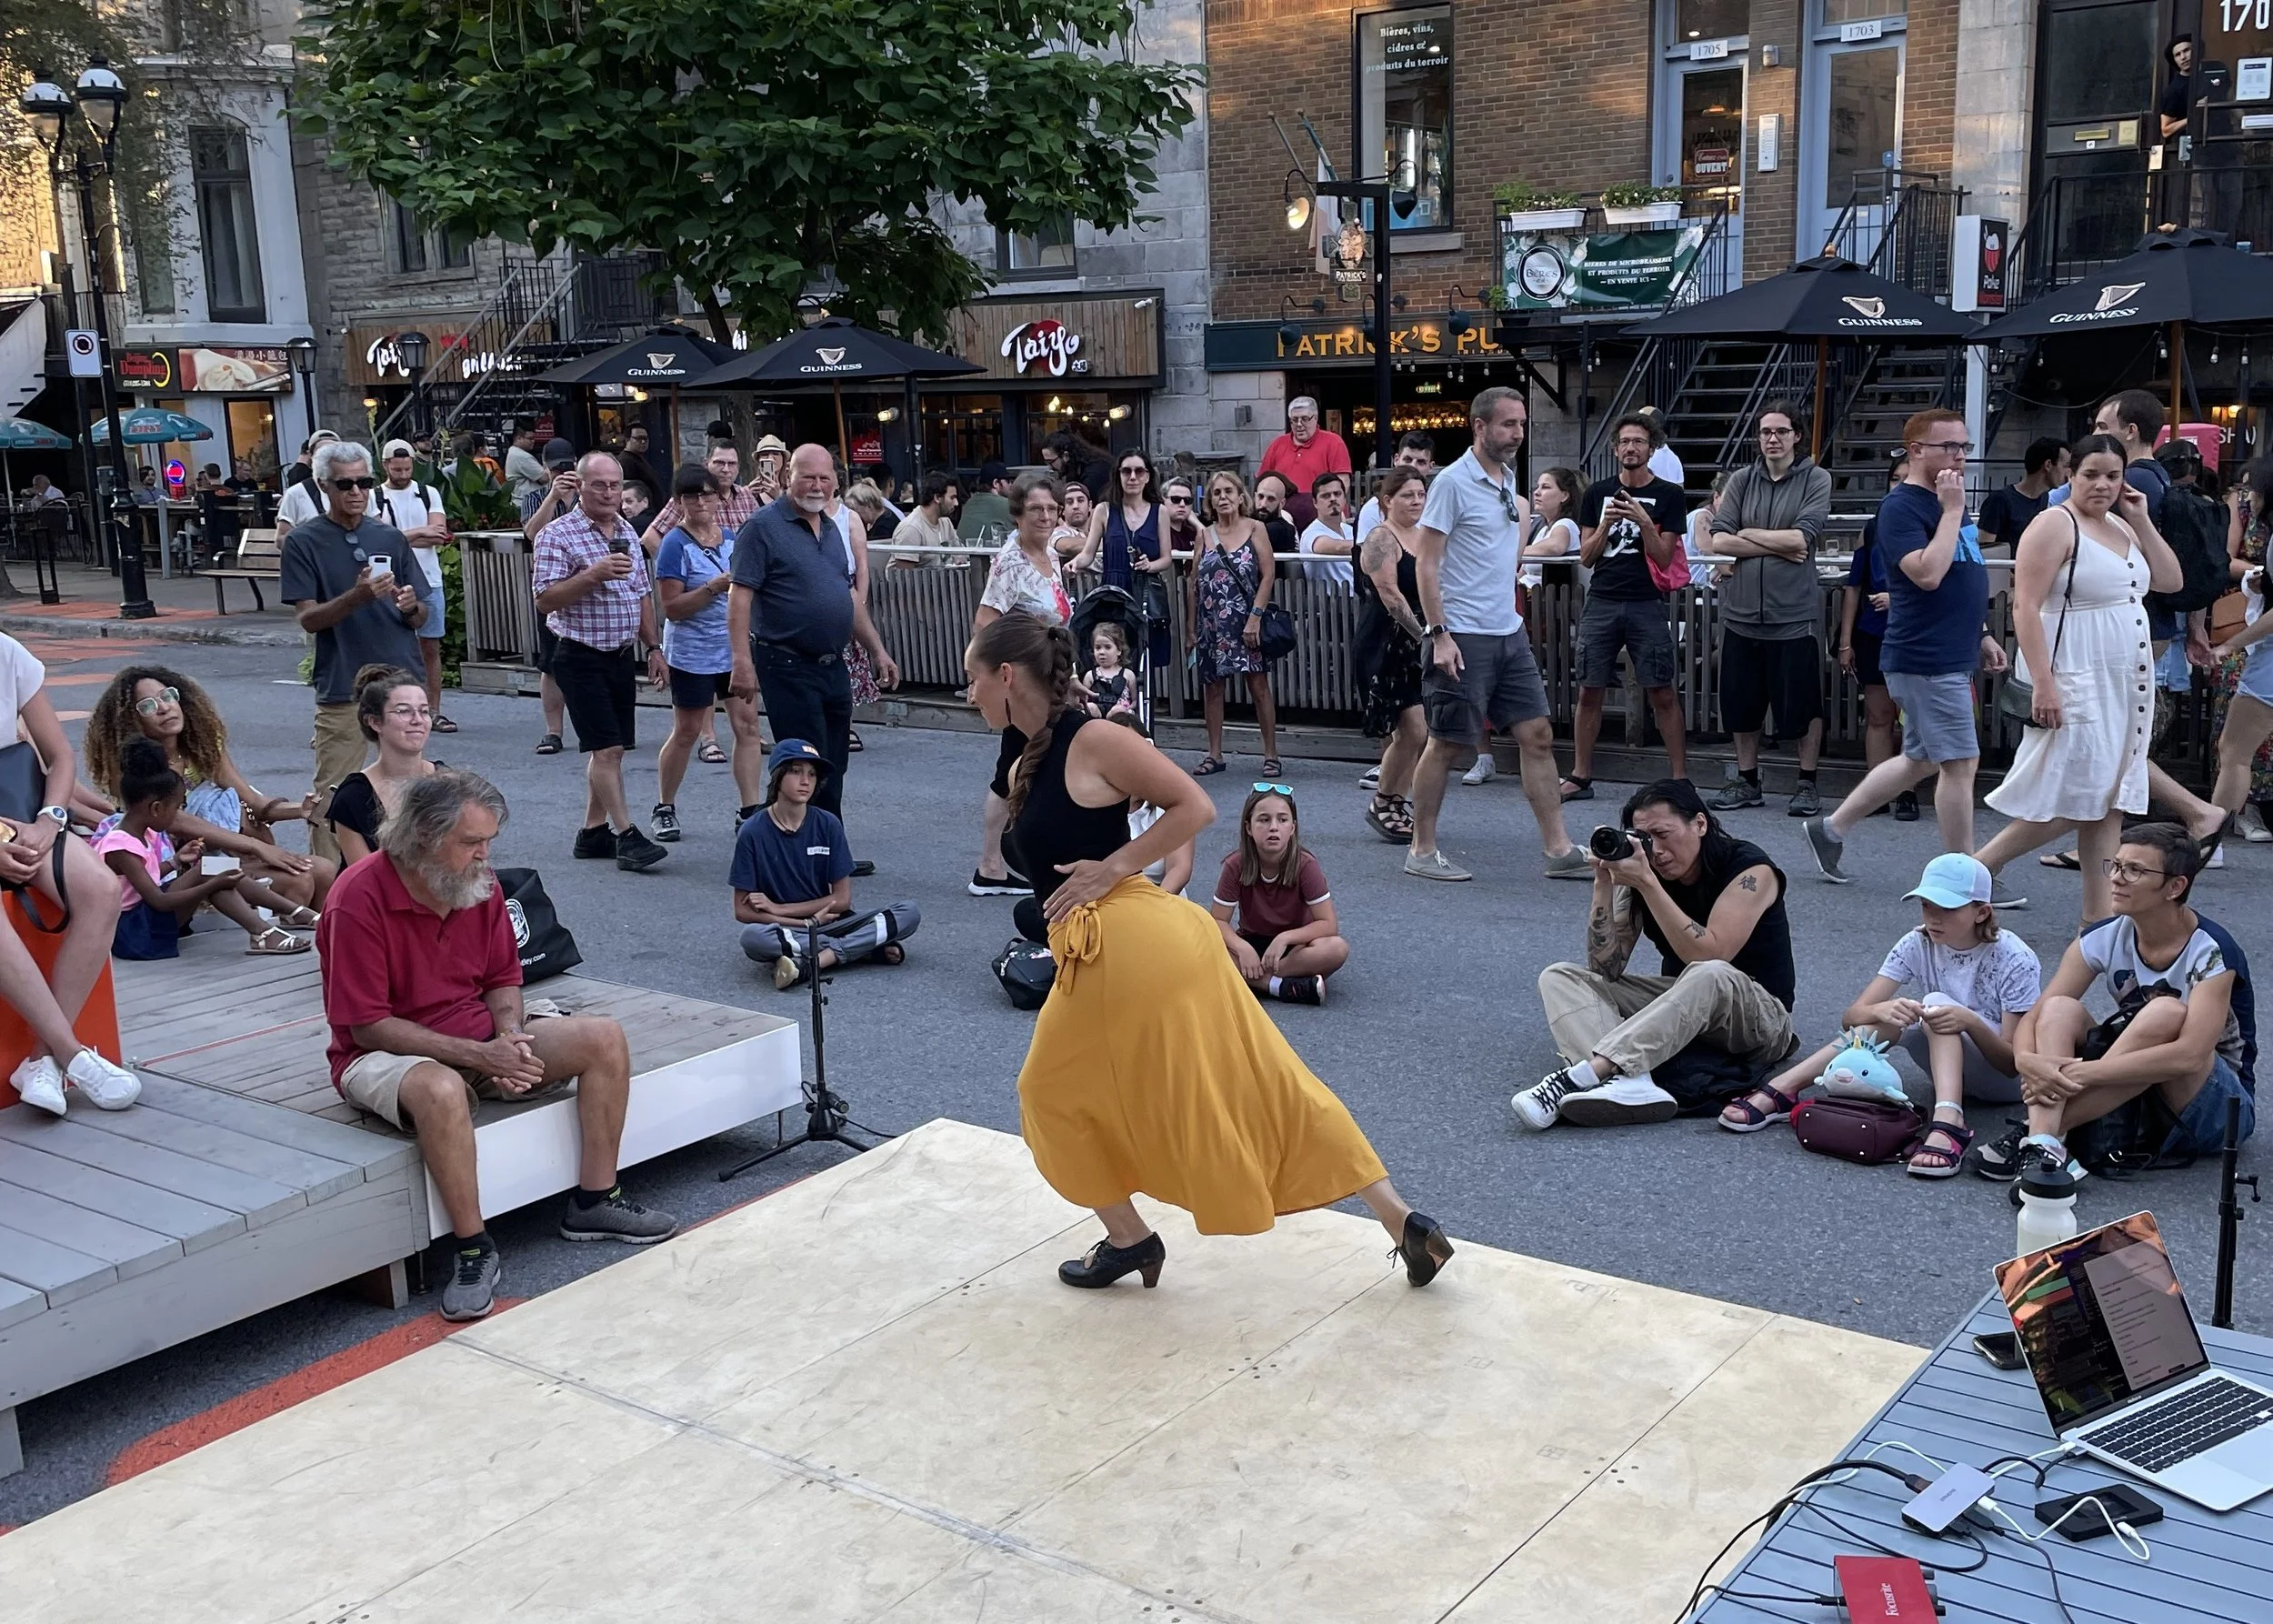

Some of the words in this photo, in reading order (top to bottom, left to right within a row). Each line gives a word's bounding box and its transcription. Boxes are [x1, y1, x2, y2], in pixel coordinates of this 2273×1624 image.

[1380, 26, 1411, 36] Bières,
[1413, 24, 1434, 34] vins,
[1848, 24, 1874, 38] 1703
[1387, 42, 1415, 54] cidres
[1697, 44, 1721, 56] 1705
[1365, 60, 1403, 73] produits
[1404, 57, 1416, 68] du
[1417, 55, 1449, 67] terroir
[1695, 162, 1727, 174] OUVERT
[1336, 271, 1367, 280] PATRICK'S
[1597, 268, 1629, 276] PRODUITS
[1837, 316, 1924, 327] GUINNESS
[2048, 306, 2139, 325] GUINNESS
[1457, 326, 1500, 352] PU
[1001, 322, 1080, 376] Taiyo
[365, 336, 411, 377] Tai
[626, 367, 686, 376] GUINNESS
[800, 363, 863, 373] GUINNESS
[1880, 1581, 1899, 1617] Focusrite
